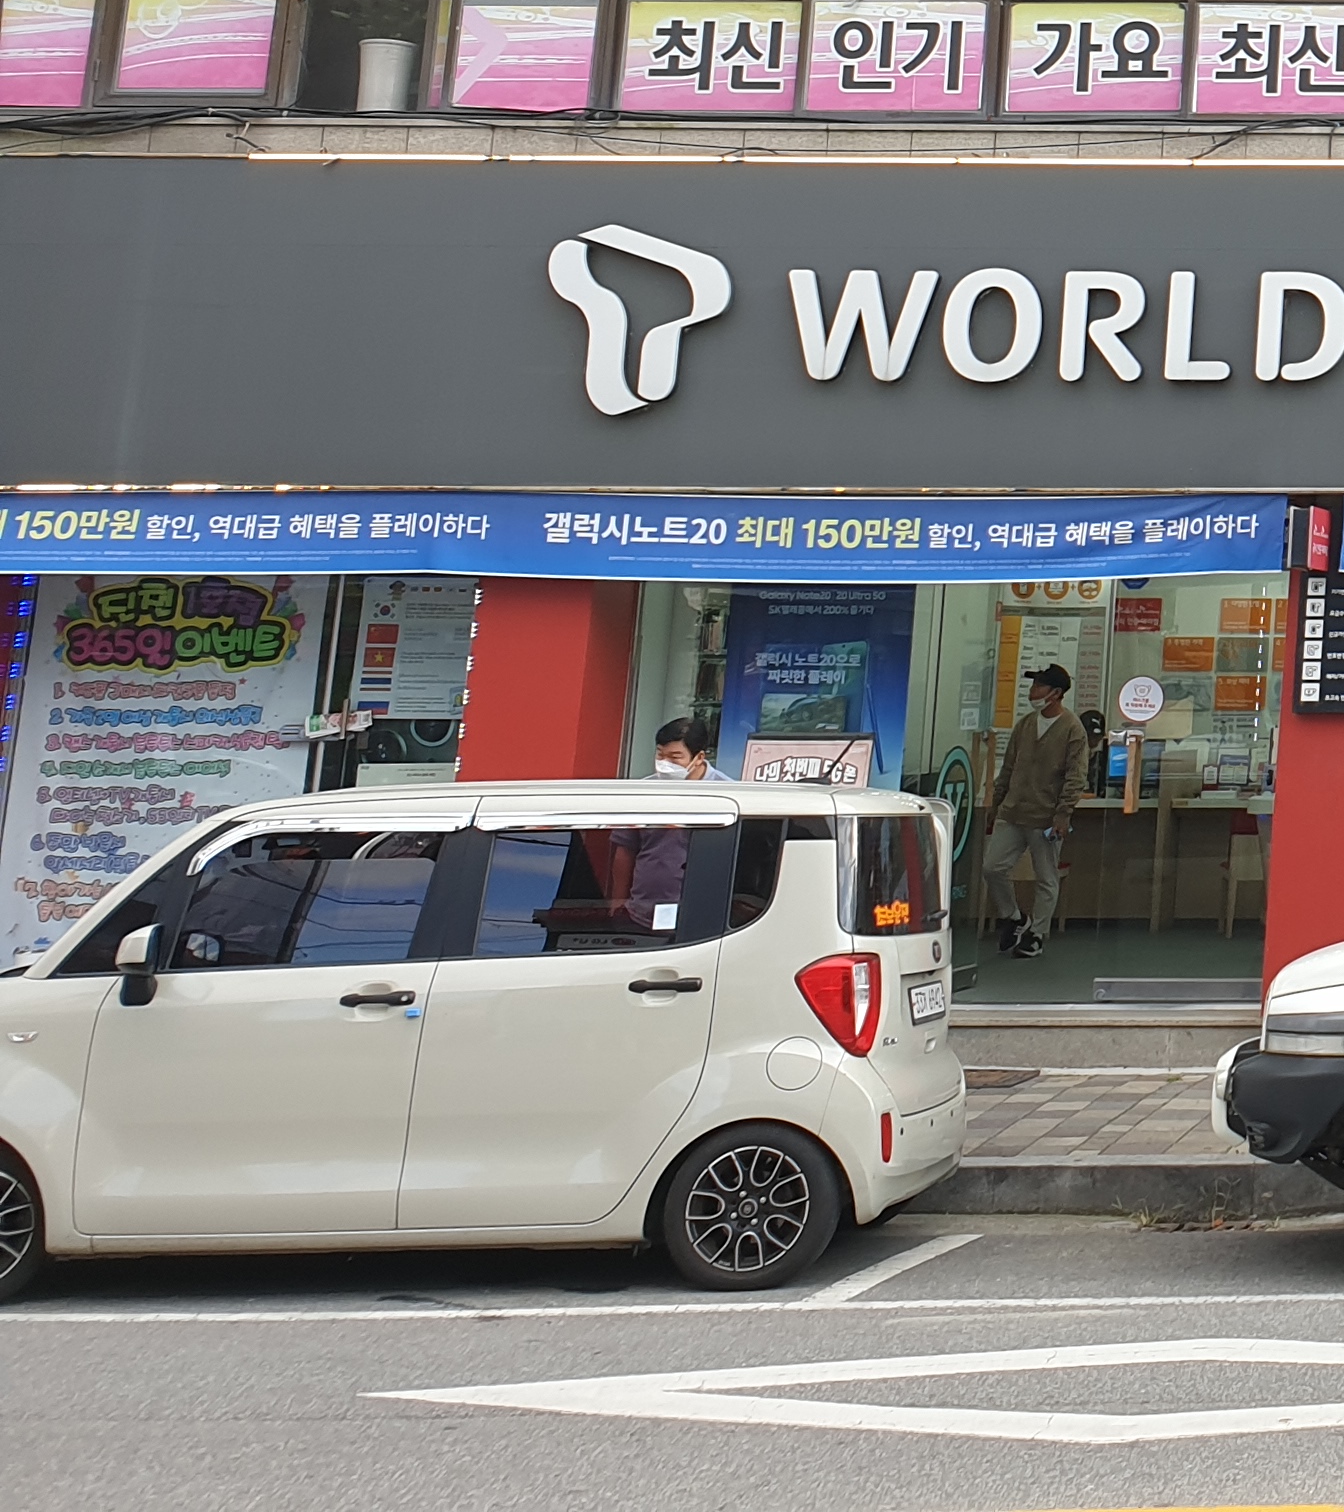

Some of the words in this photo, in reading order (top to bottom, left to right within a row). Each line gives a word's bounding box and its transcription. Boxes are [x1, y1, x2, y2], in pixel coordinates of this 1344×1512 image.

[646, 19, 787, 93] 최신
[831, 19, 966, 94] 인기
[1032, 19, 1172, 96] 가요
[14, 510, 140, 541] 150만원
[146, 514, 200, 544] 할인,
[208, 513, 282, 540] 역대급
[289, 512, 363, 540] 혜택을
[369, 510, 490, 541] 플레이하다
[542, 511, 728, 547] 갤럭시노트20
[735, 515, 794, 549] 최대
[804, 516, 921, 551] 150만원
[928, 522, 981, 553] 할인,
[987, 520, 1058, 549] 역대급
[1065, 517, 1135, 547] 혜택을
[1142, 513, 1259, 543] 플레이하다
[759, 590, 796, 602] Galaxy
[70, 626, 173, 666] 365일
[175, 624, 281, 663] 이벤트
[755, 652, 792, 667] 갤럭시
[793, 653, 861, 667] 노트20으로
[767, 670, 806, 684] 짜릿한
[808, 669, 846, 685] 플레이
[755, 760, 781, 782] 나의
